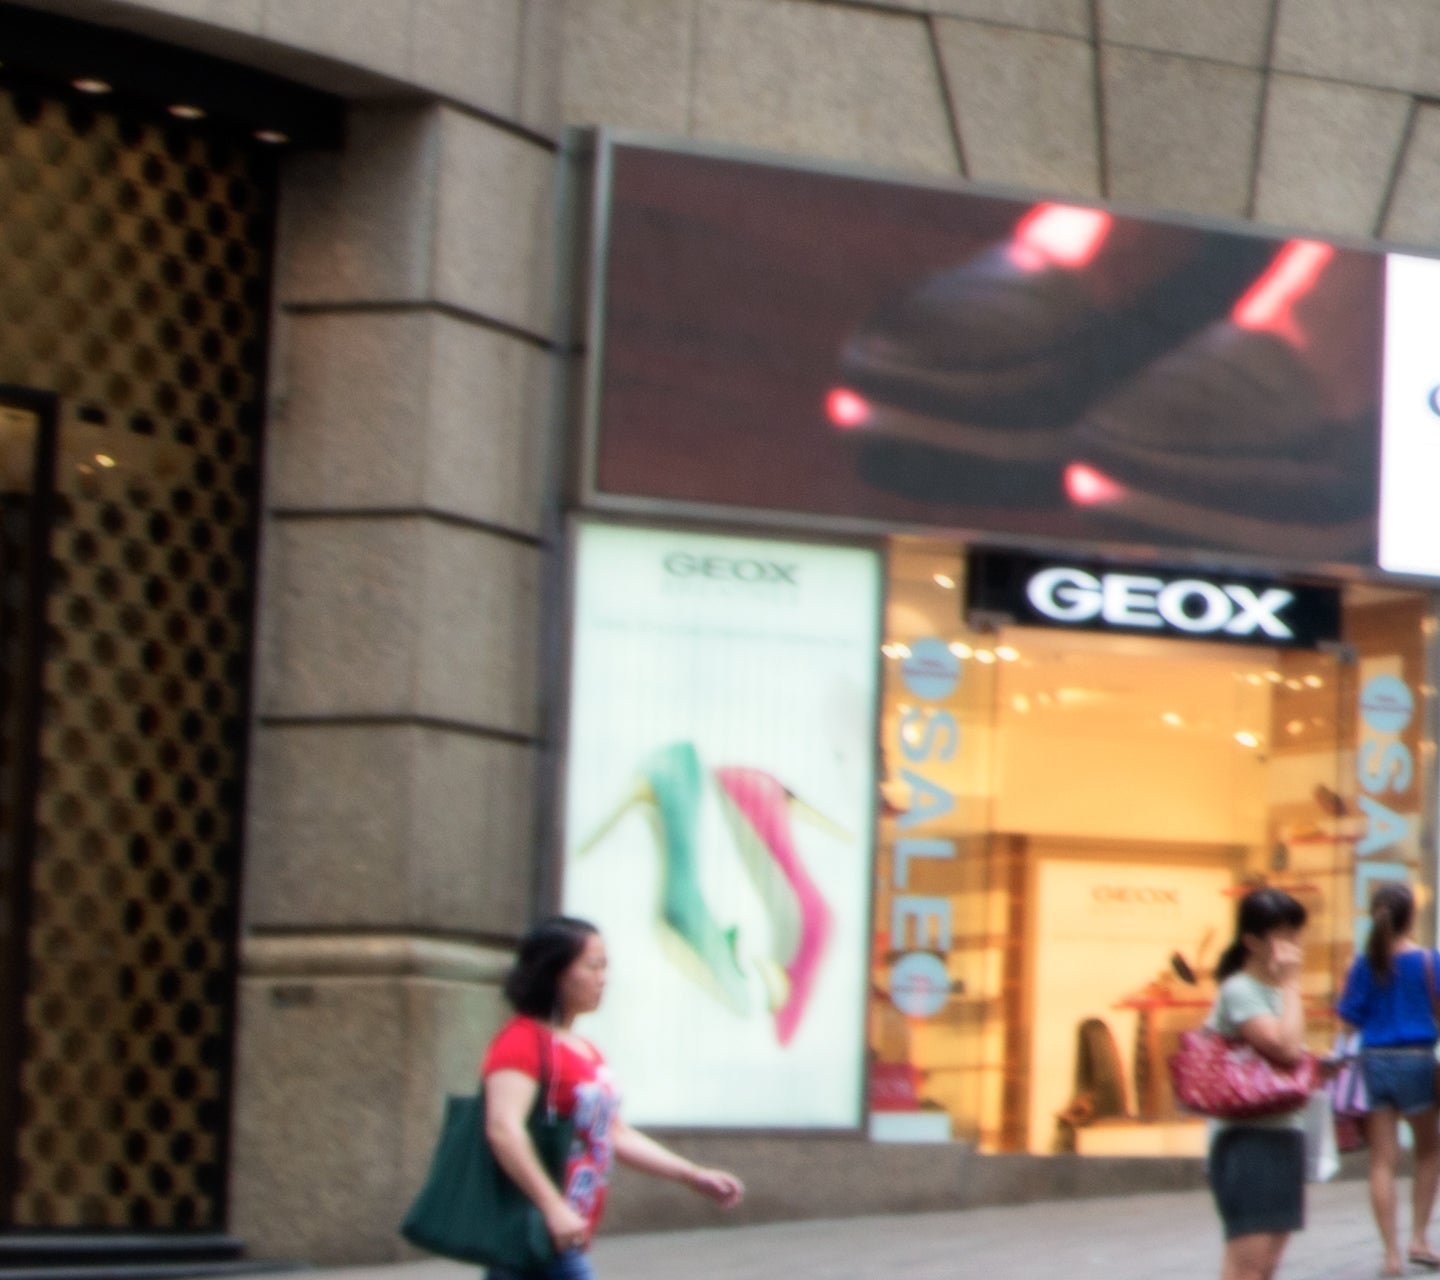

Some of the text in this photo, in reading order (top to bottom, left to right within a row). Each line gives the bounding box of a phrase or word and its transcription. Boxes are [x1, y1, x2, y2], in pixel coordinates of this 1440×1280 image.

[662, 549, 798, 587] GEOX
[1027, 567, 1296, 641] GEOX
[892, 704, 959, 953] SALE
